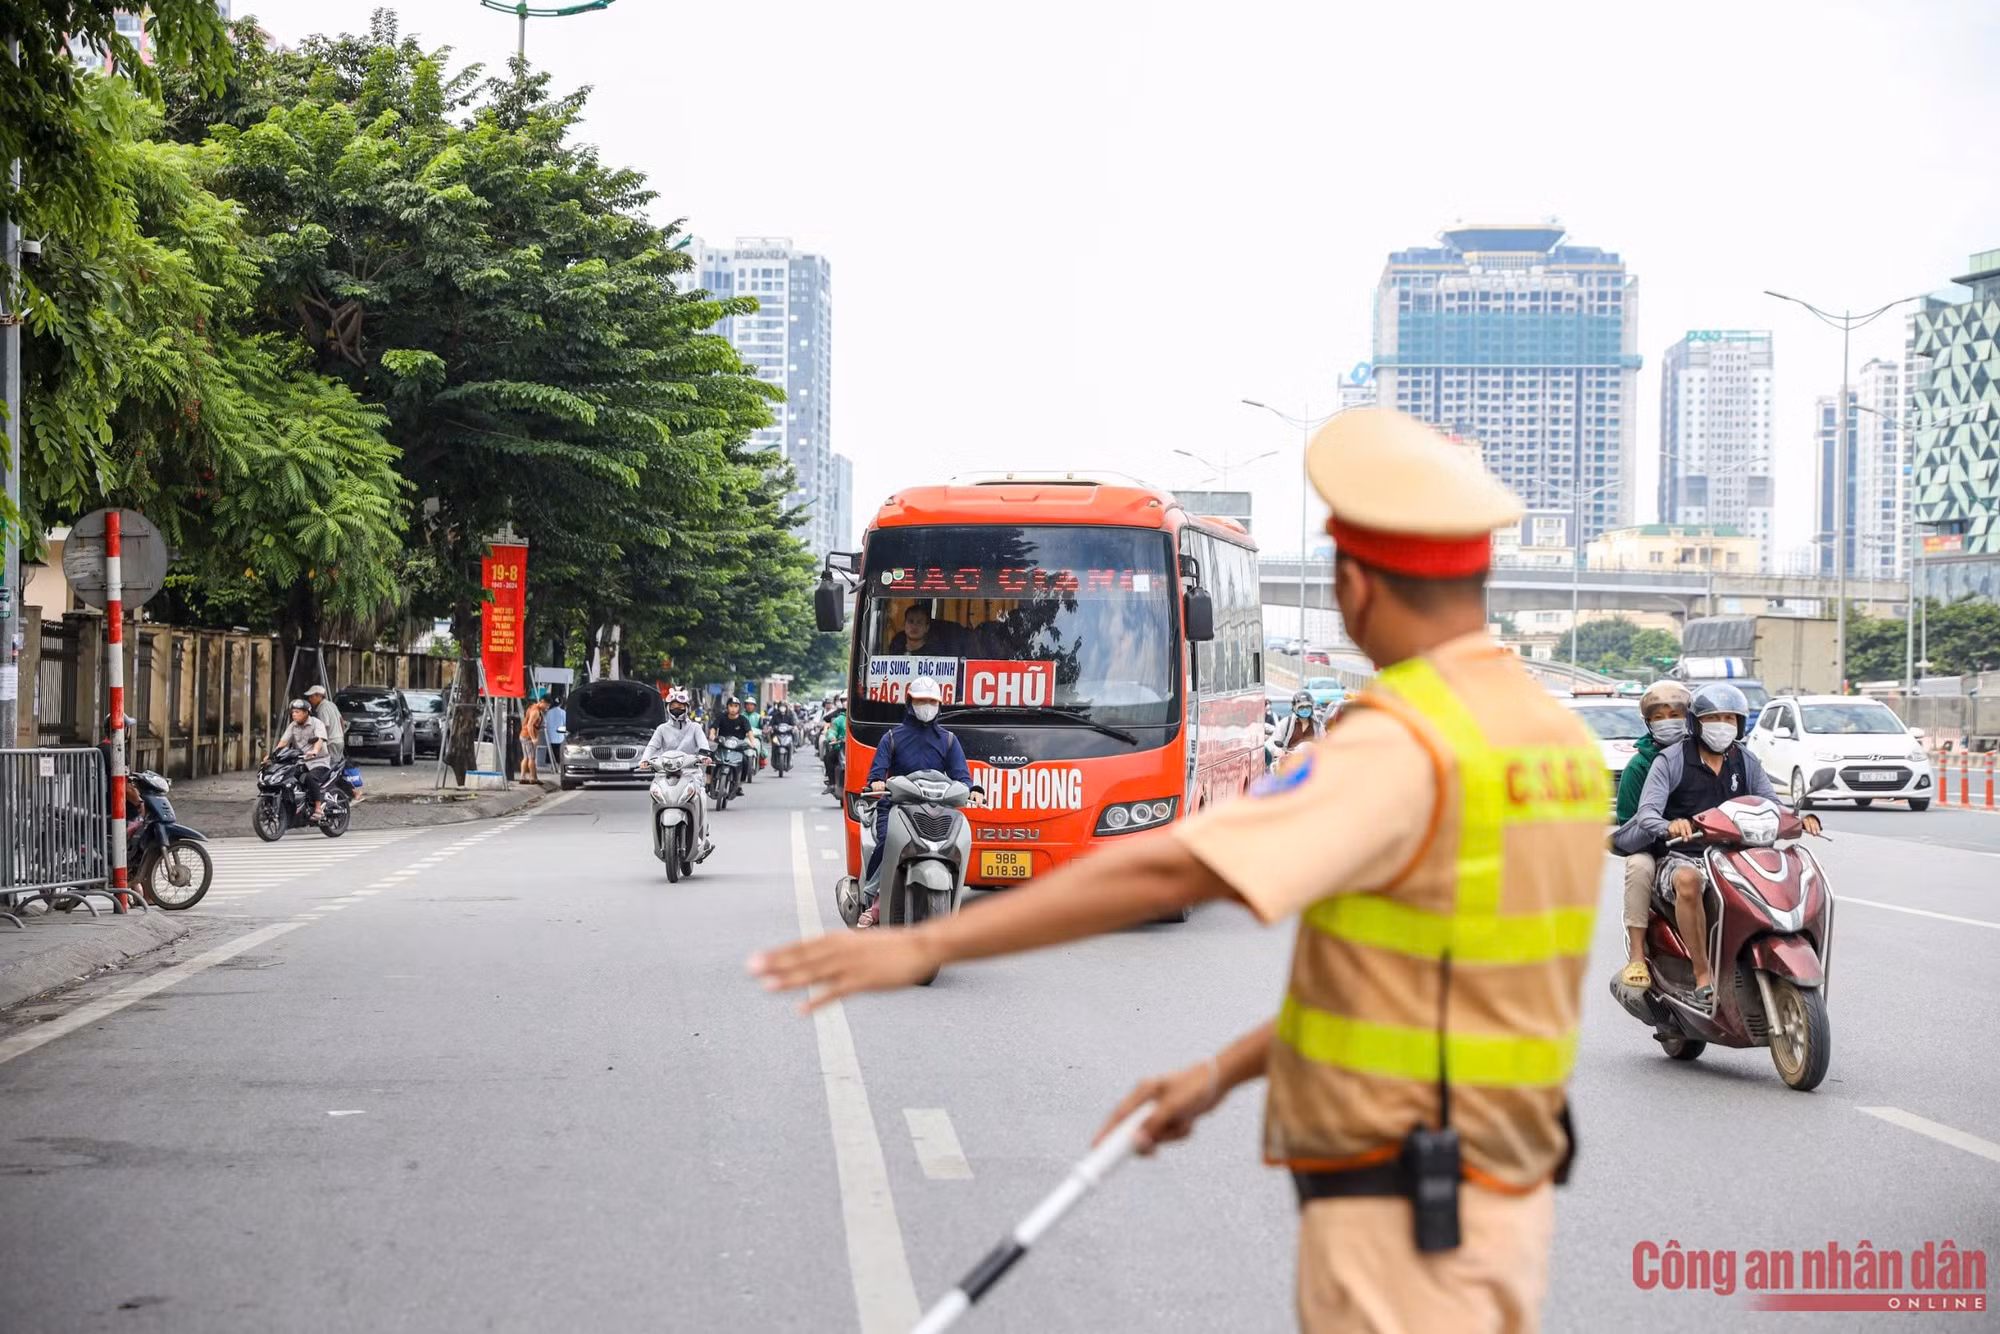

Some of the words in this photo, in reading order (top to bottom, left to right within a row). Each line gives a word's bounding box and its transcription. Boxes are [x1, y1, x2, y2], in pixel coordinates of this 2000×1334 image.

[491, 564, 518, 581] 19-8
[870, 660, 888, 676] SAM
[889, 660, 911, 676] SUNG
[935, 661, 956, 677] NINH
[972, 665, 1046, 707] CHŨ
[989, 755, 1028, 765] SAMCO
[1007, 767, 1083, 810] PHONG
[995, 853, 1018, 864] 98B
[986, 865, 1026, 877] 018.98
